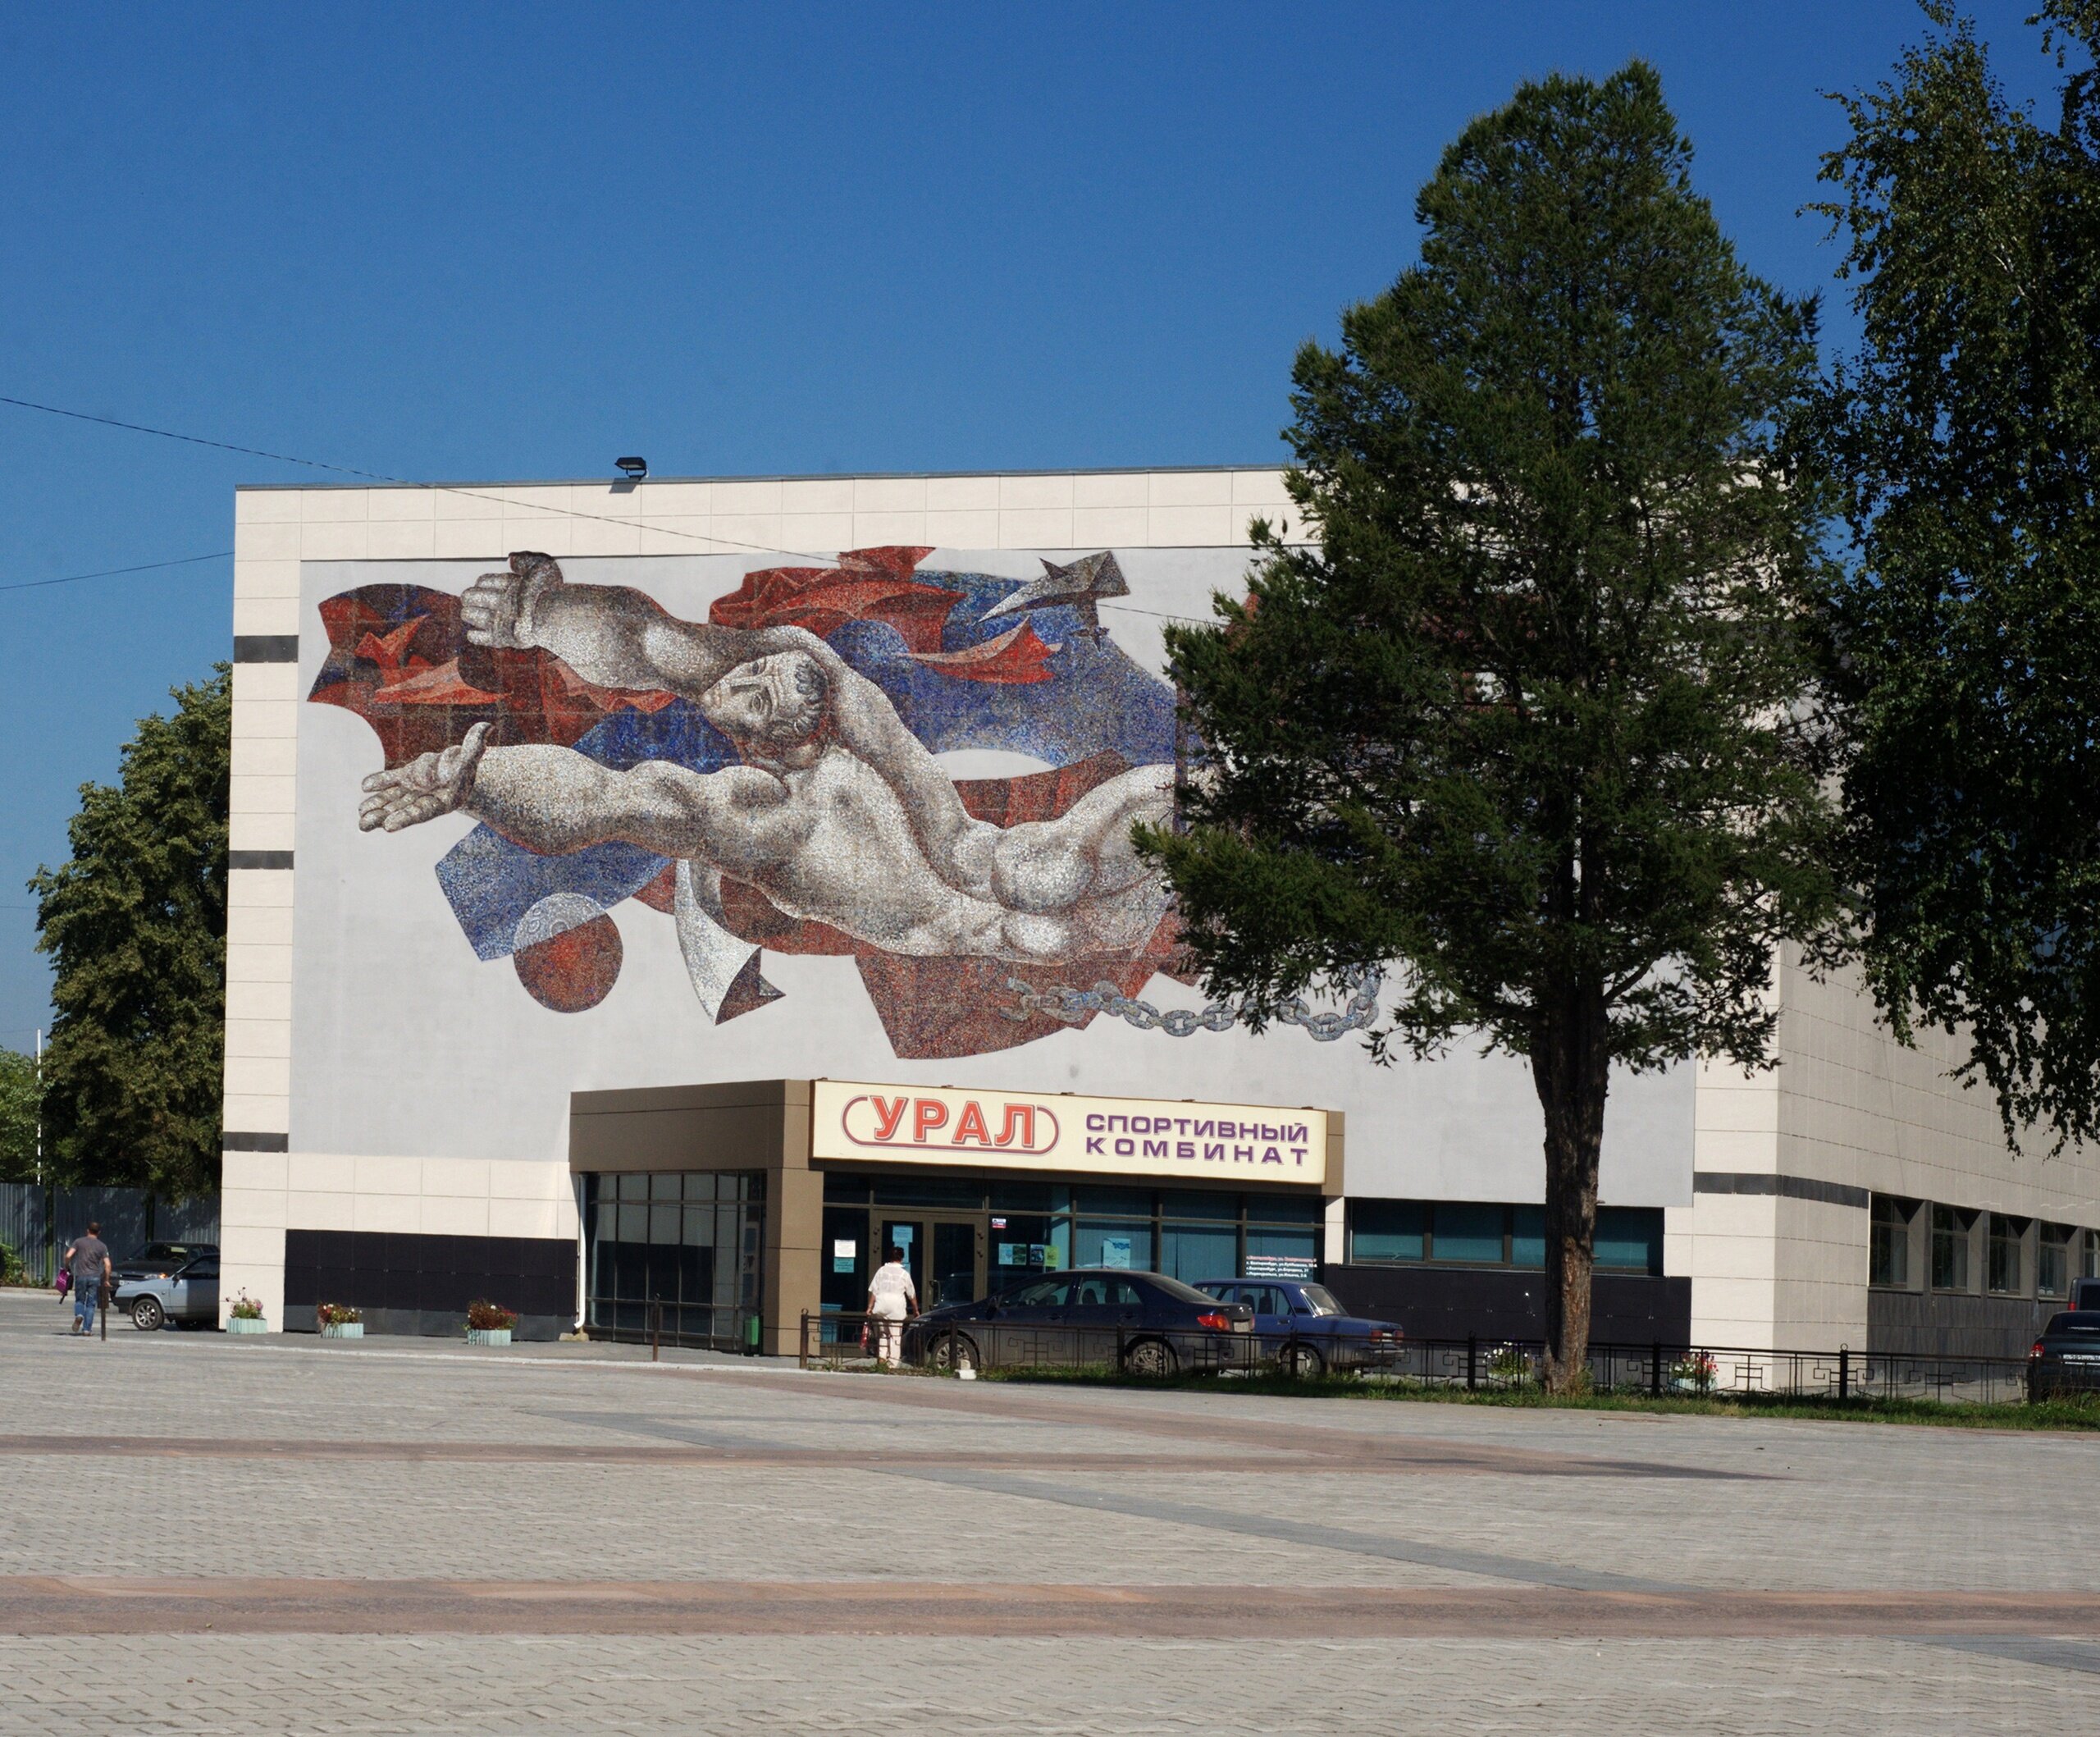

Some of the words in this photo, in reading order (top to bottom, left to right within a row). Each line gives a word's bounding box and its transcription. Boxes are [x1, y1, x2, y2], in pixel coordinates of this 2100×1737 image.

[870, 1095, 1035, 1149] УРАЛ
[1085, 1113, 1308, 1143] СПОРТИВНЫЙ
[1085, 1136, 1308, 1166] КОМБИНАТ
